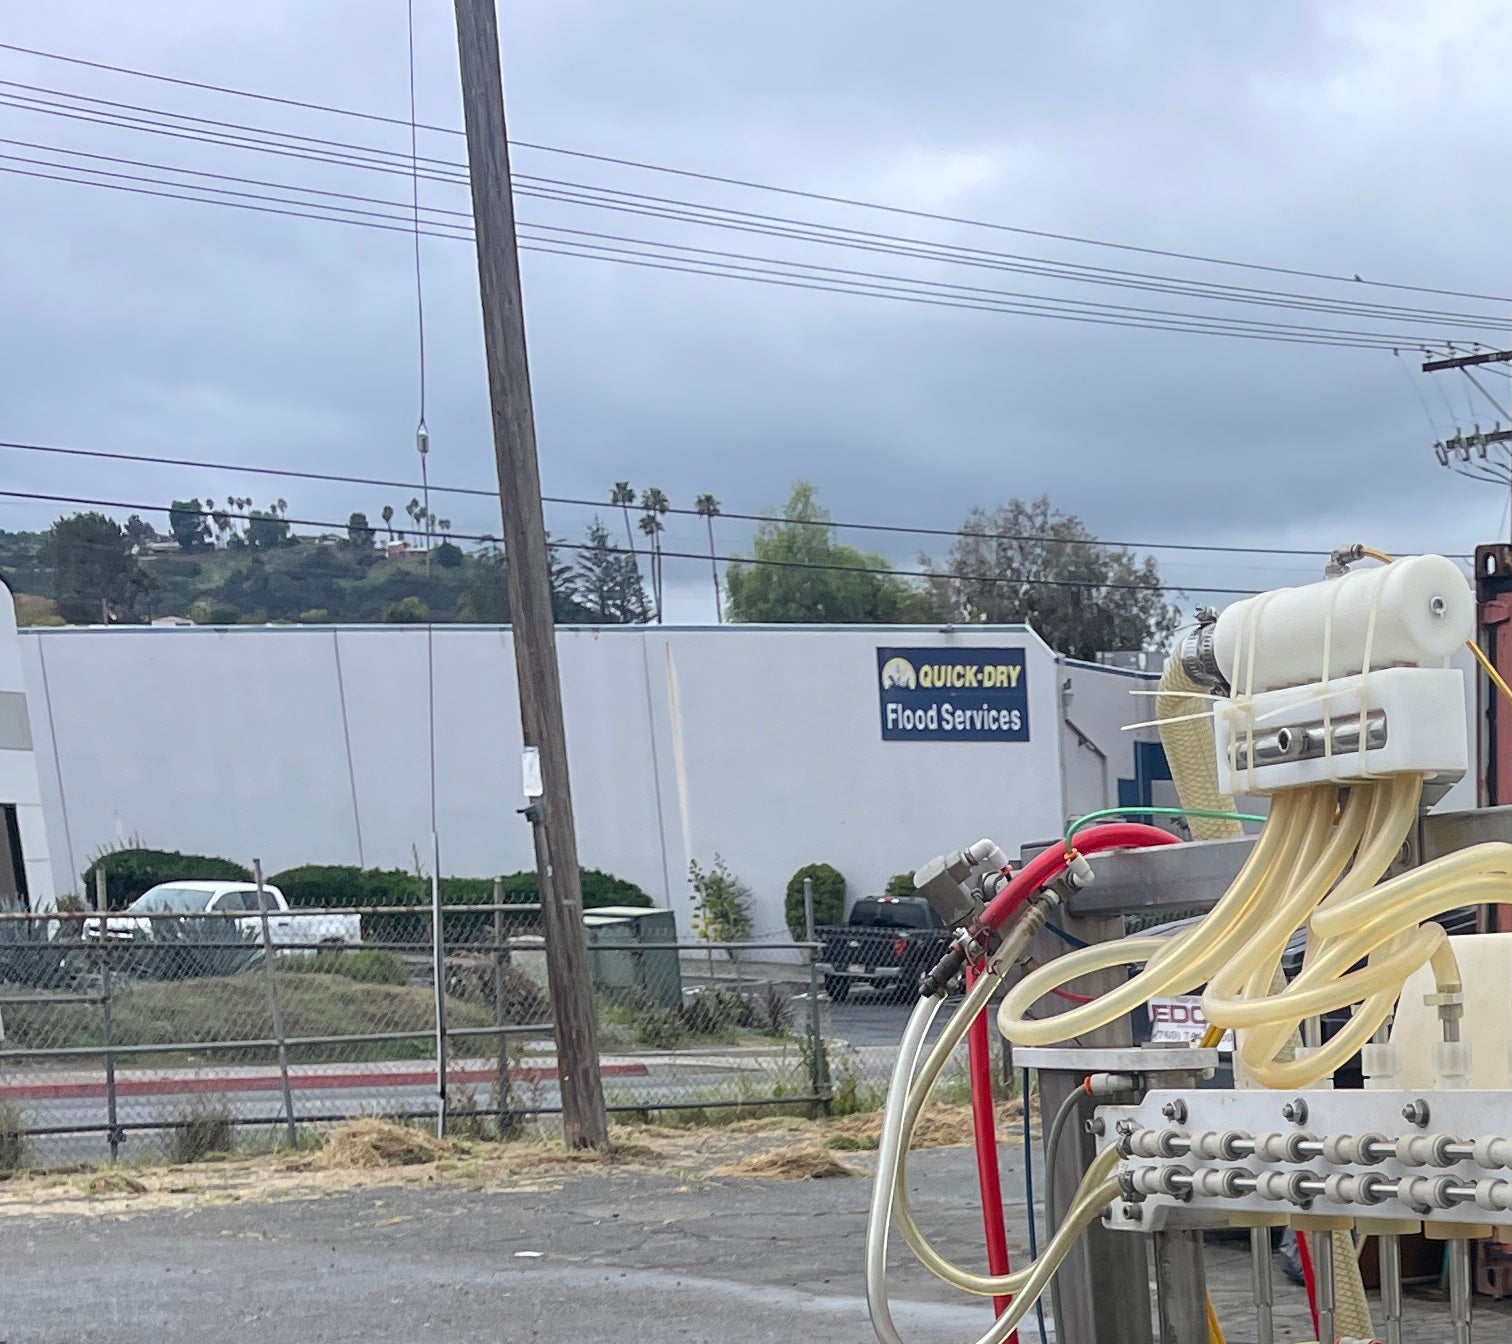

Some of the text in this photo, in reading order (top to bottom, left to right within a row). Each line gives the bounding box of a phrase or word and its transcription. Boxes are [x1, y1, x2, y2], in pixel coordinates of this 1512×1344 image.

[919, 664, 1022, 689] QUICK-DRY
[886, 702, 1022, 732] Flood Services
